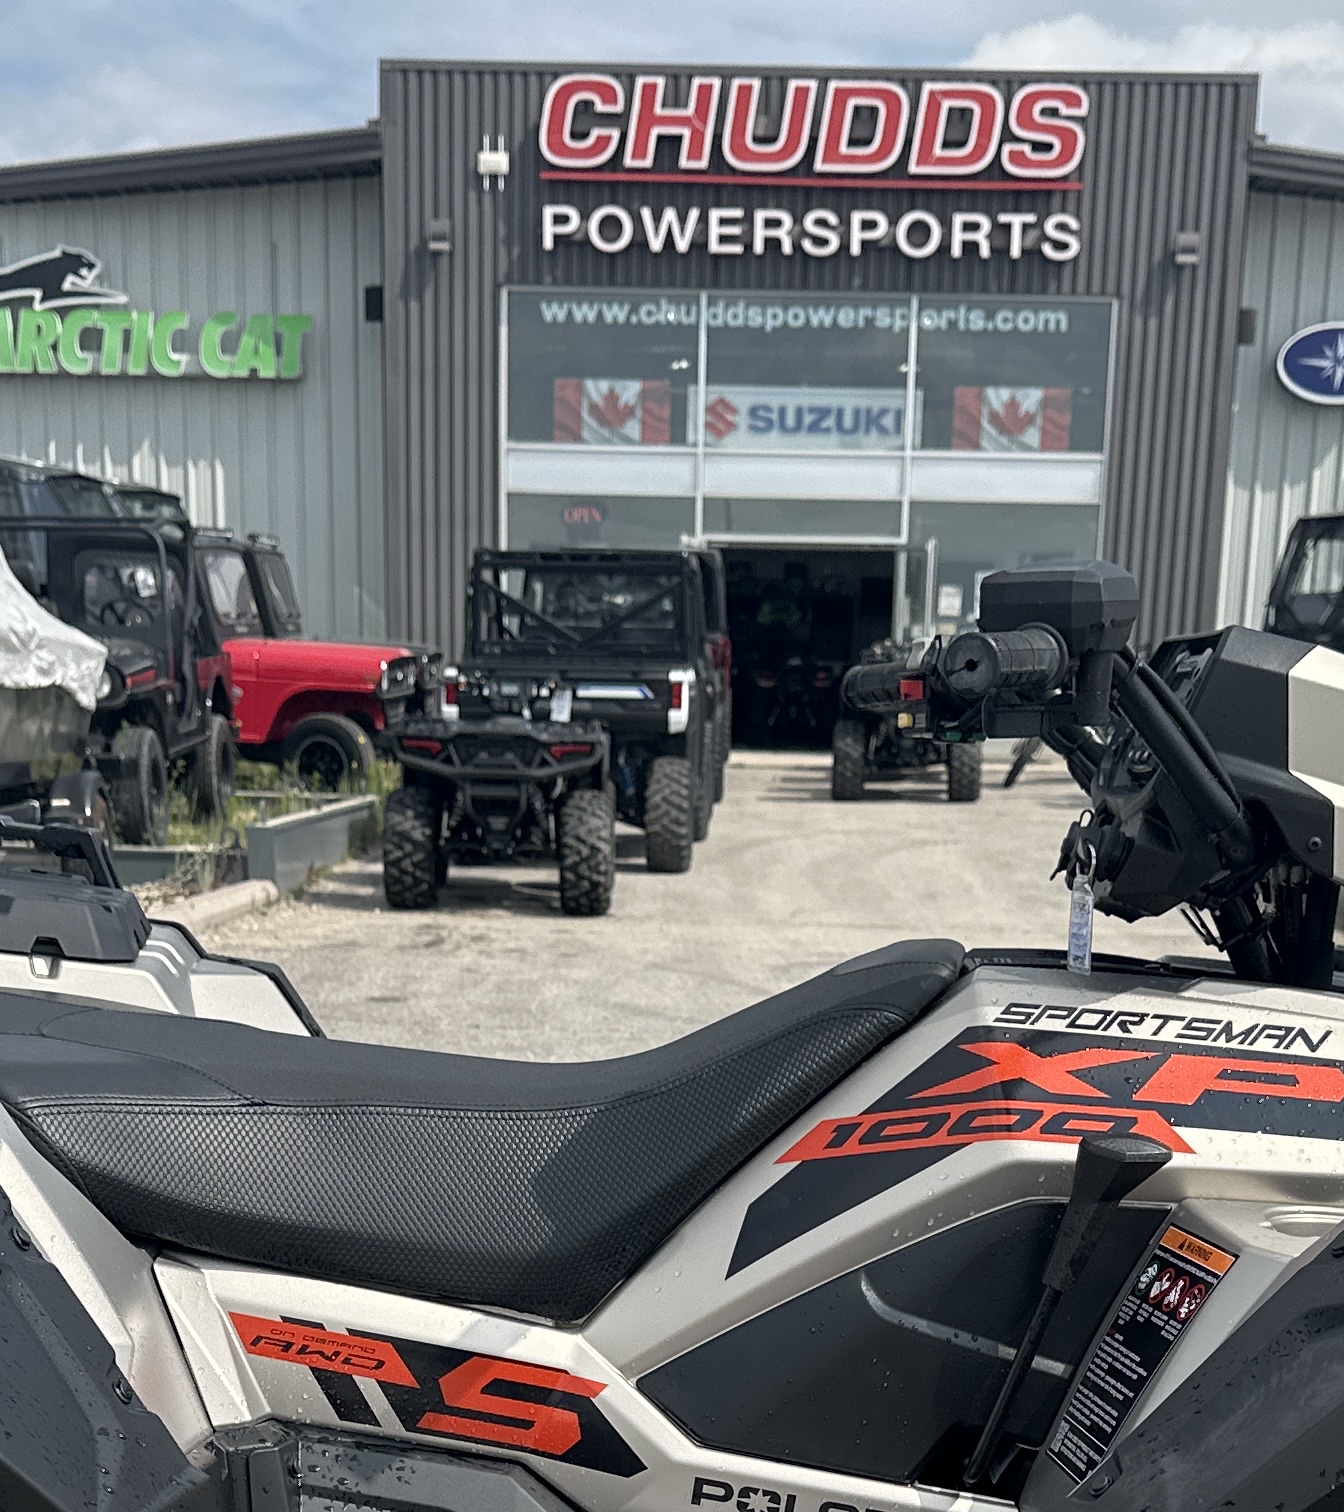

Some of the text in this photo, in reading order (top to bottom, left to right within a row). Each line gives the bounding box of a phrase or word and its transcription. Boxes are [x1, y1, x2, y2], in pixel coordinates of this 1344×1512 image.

[539, 73, 1090, 178] CHUDDS
[541, 204, 1082, 262] POWERSPORTS
[541, 299, 1069, 334] www.chuddspowersports.com
[198, 311, 314, 380] CAT
[746, 403, 903, 438] SUZUKI
[993, 1002, 1333, 1055] SPORTSMAN
[822, 1107, 1139, 1151] 1000
[248, 1334, 386, 1371] AWD
[270, 1328, 376, 1355] ON DEMAND
